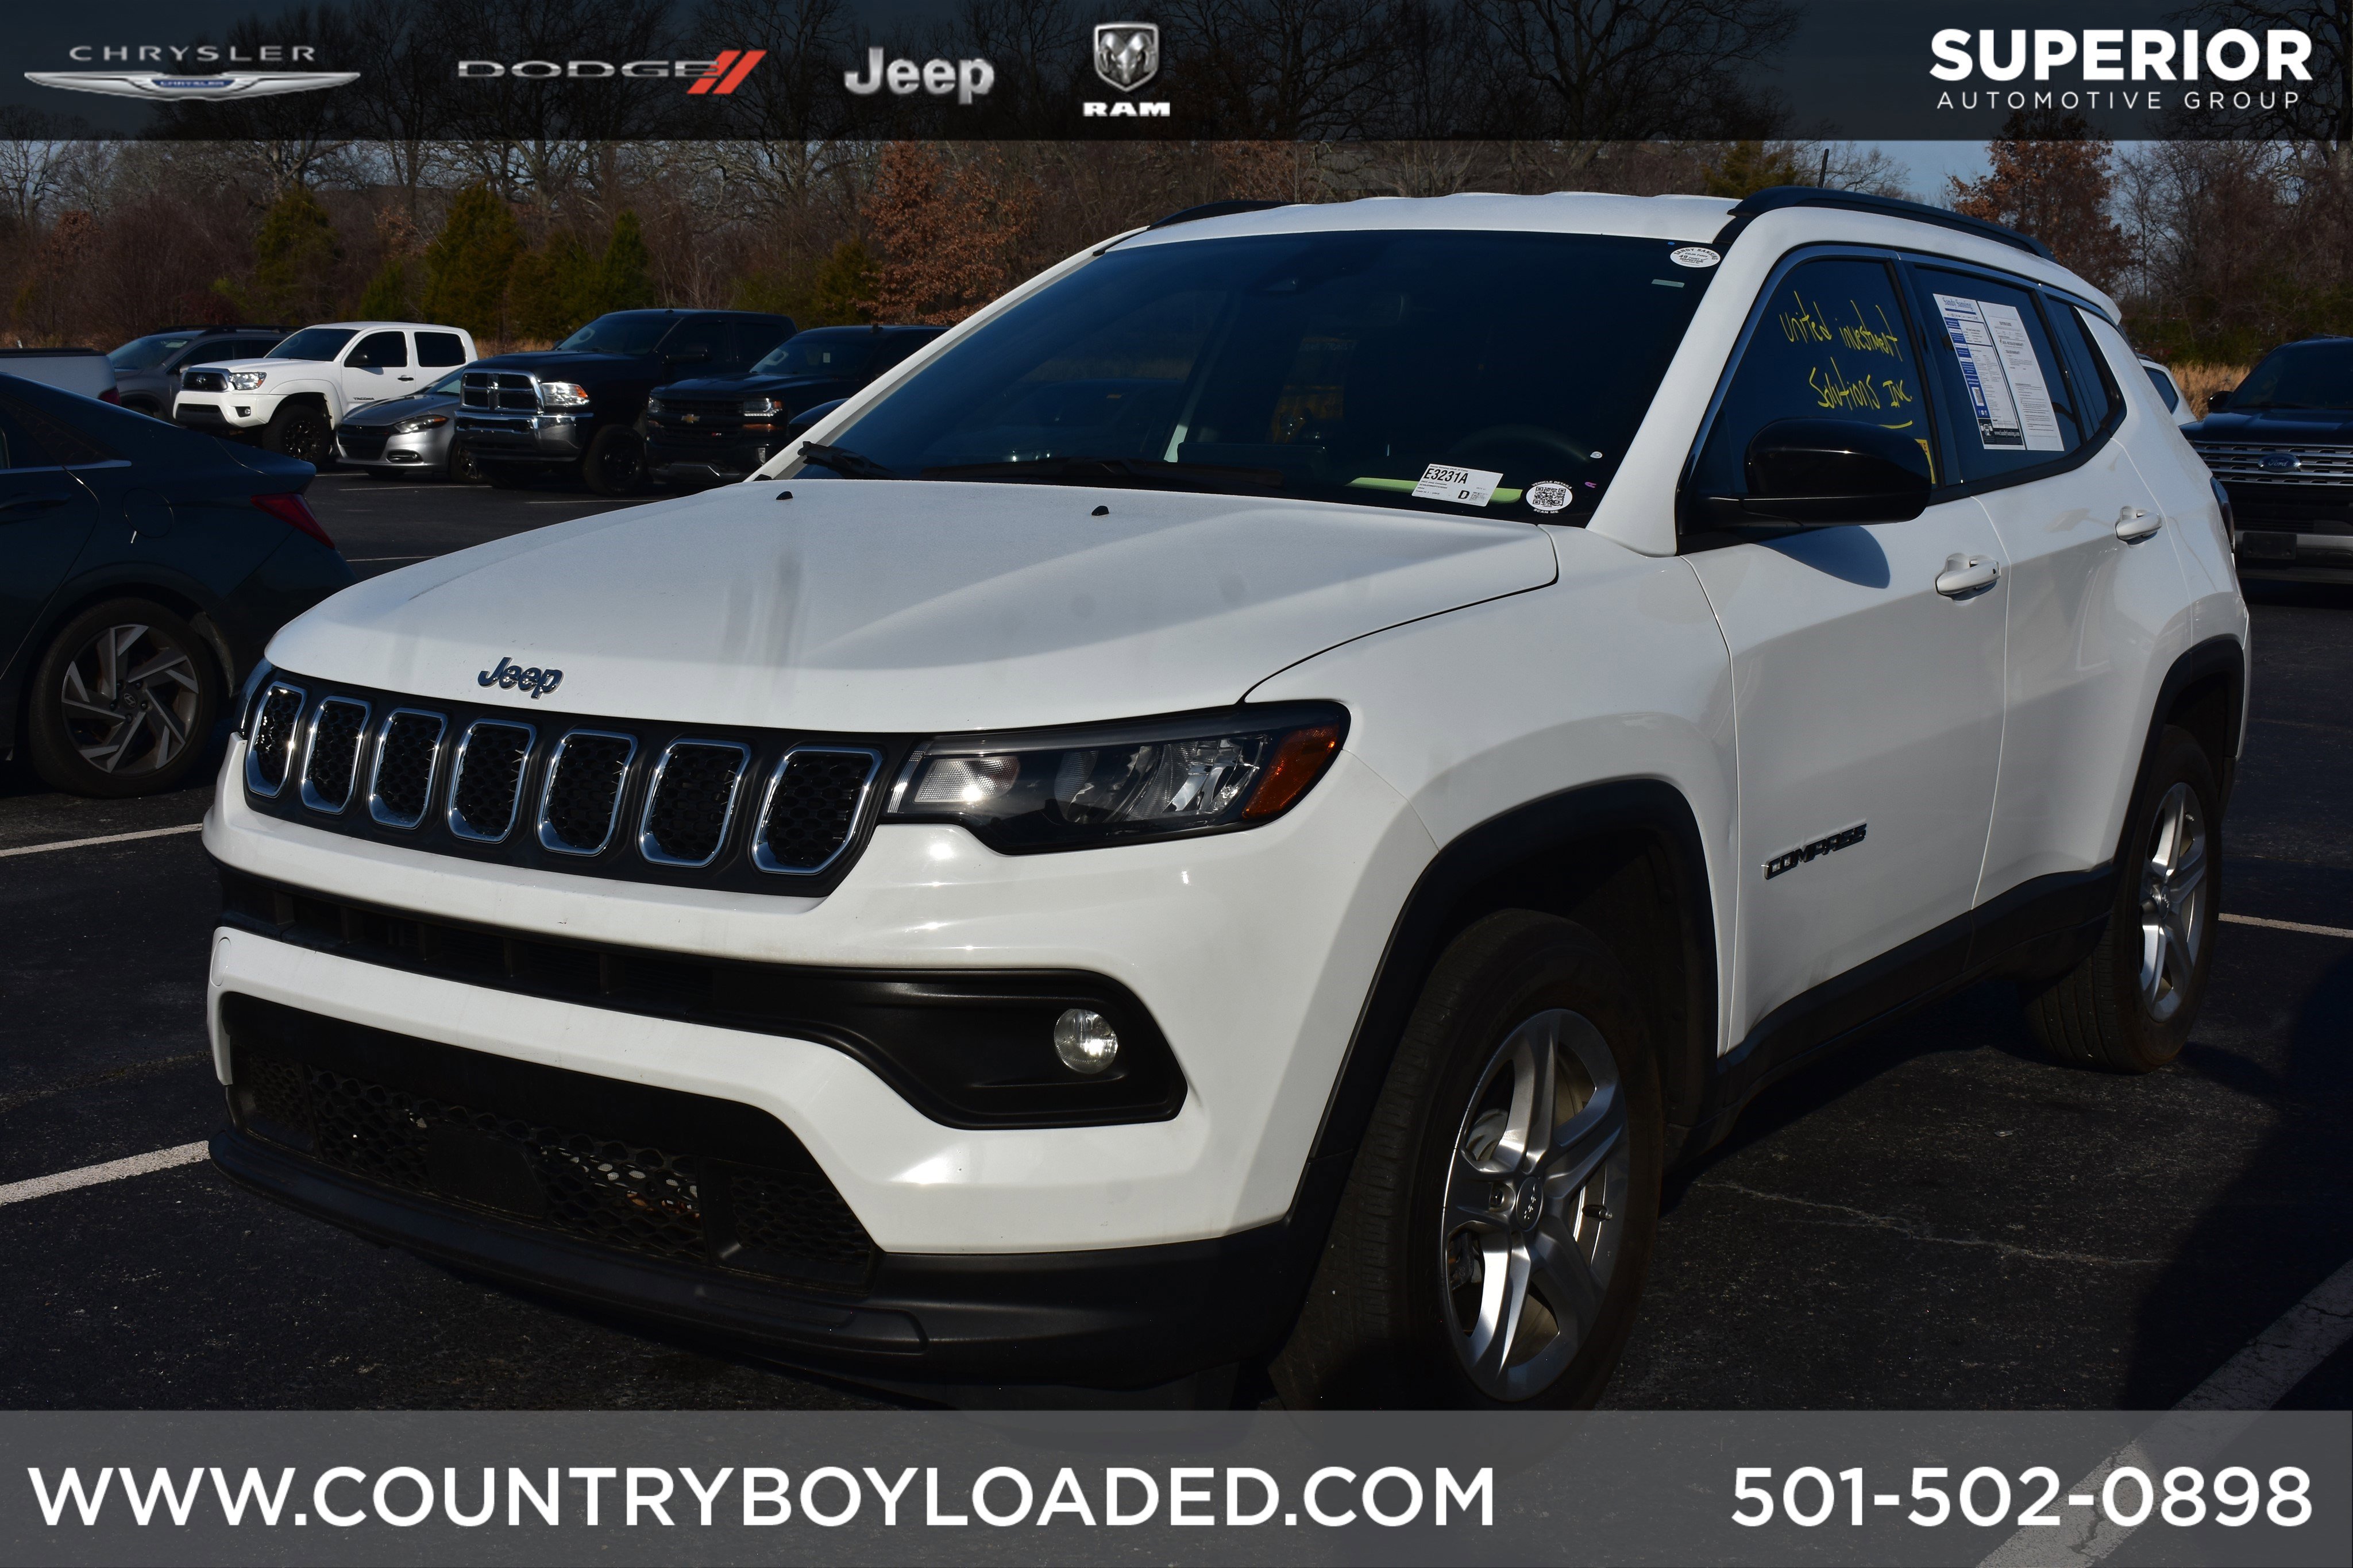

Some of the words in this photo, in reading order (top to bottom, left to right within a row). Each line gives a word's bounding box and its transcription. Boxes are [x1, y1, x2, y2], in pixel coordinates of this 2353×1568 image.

[2268, 459, 2289, 467] Ford
[1423, 468, 1469, 484] E3231A
[1553, 481, 1572, 489] DETAILS
[1457, 490, 1470, 499] D
[477, 656, 564, 700] Jeep
[1764, 822, 1867, 880] COMPASS
